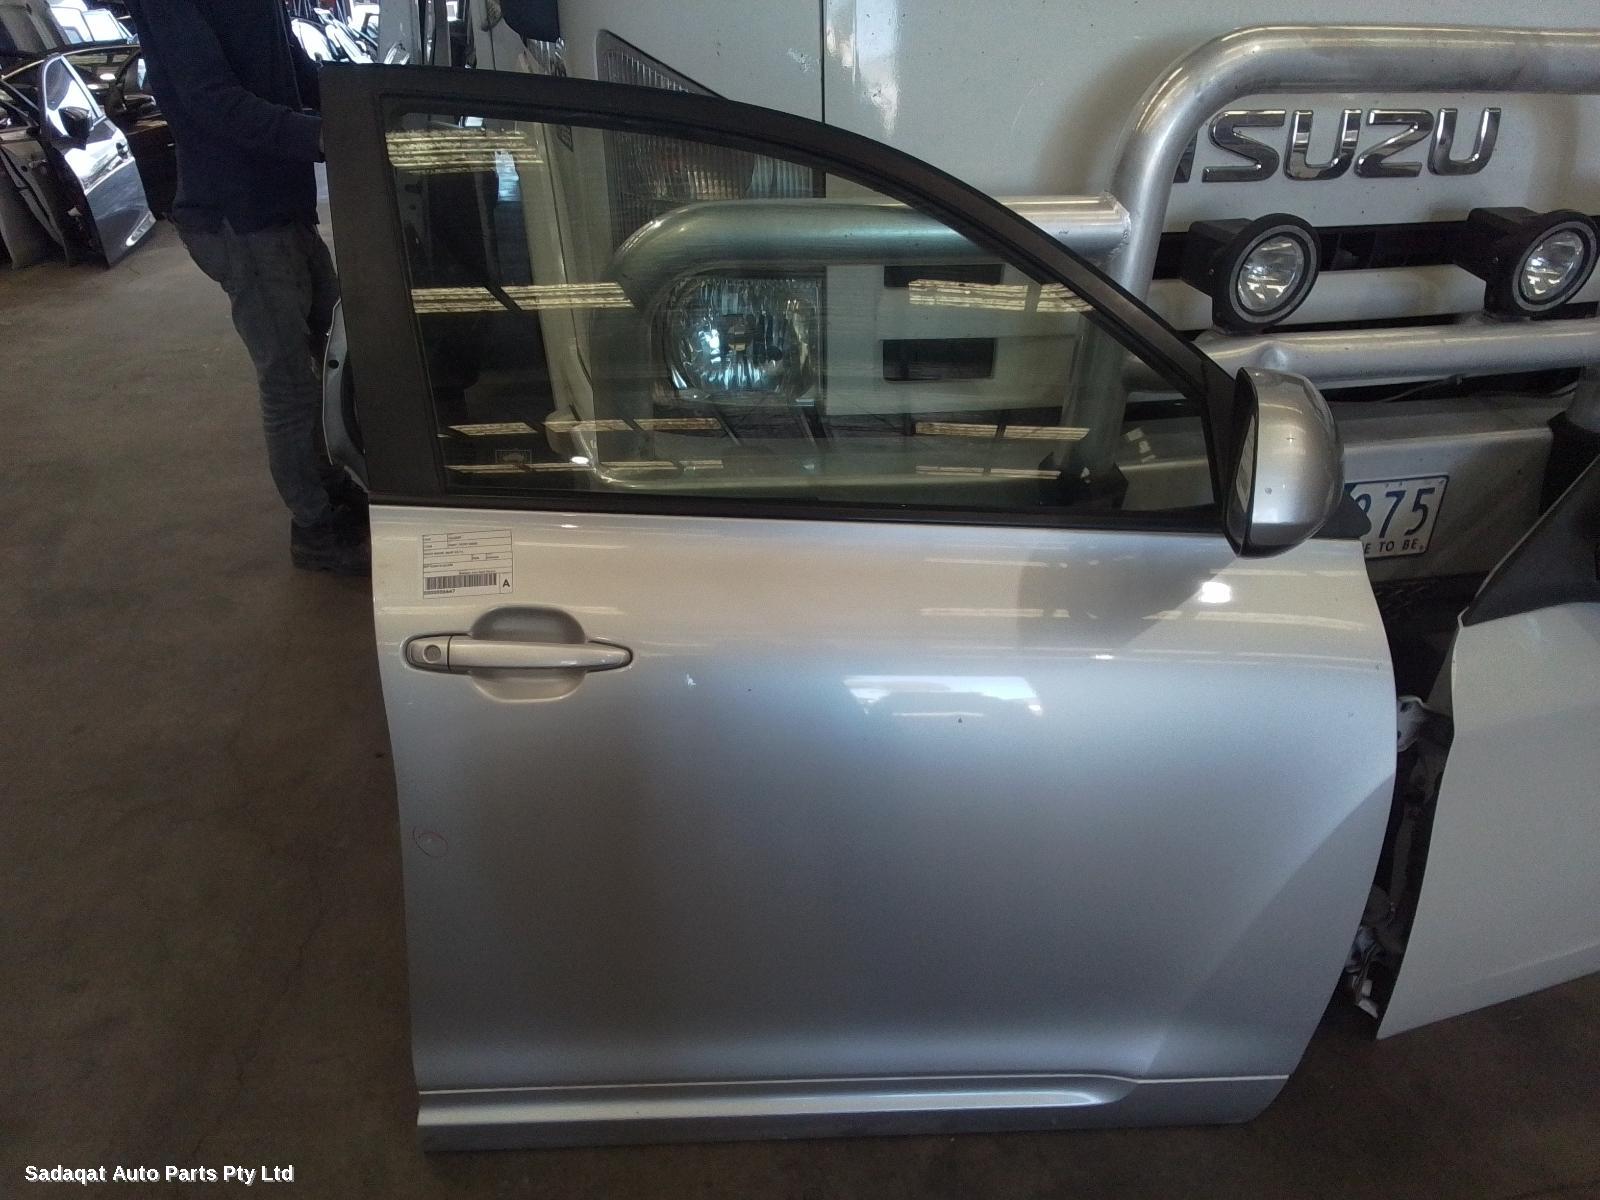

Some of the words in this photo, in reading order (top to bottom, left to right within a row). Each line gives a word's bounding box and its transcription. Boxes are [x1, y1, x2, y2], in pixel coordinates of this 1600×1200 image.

[1379, 541, 1395, 552] TO
[1402, 538, 1418, 550] BE
[502, 579, 511, 588] A
